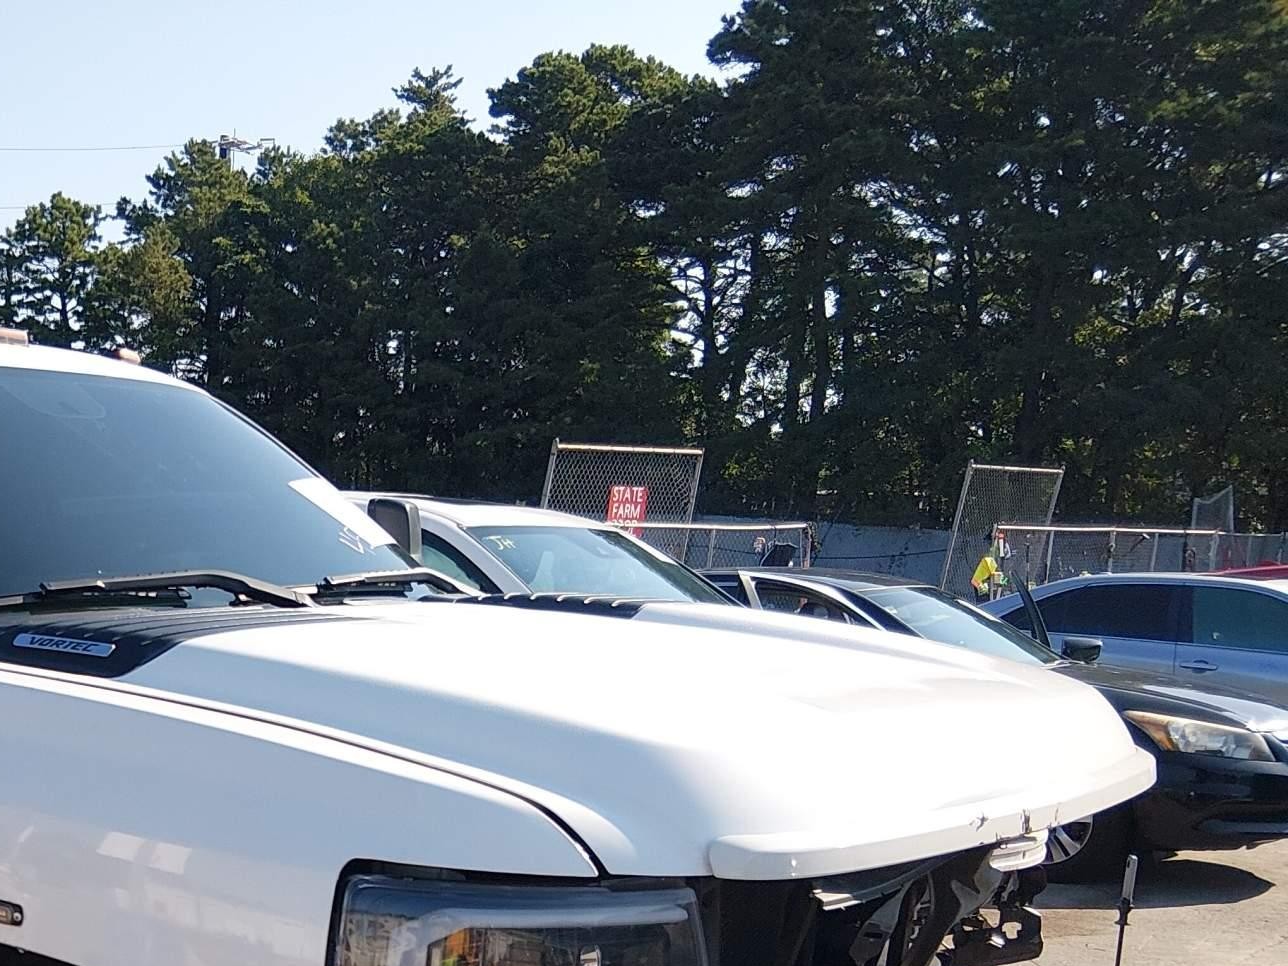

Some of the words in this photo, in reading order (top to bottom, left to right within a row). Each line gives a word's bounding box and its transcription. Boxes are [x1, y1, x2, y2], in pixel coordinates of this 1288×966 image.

[612, 486, 644, 502] STATE
[611, 503, 641, 519] FARM
[28, 636, 98, 652] VORTEC
